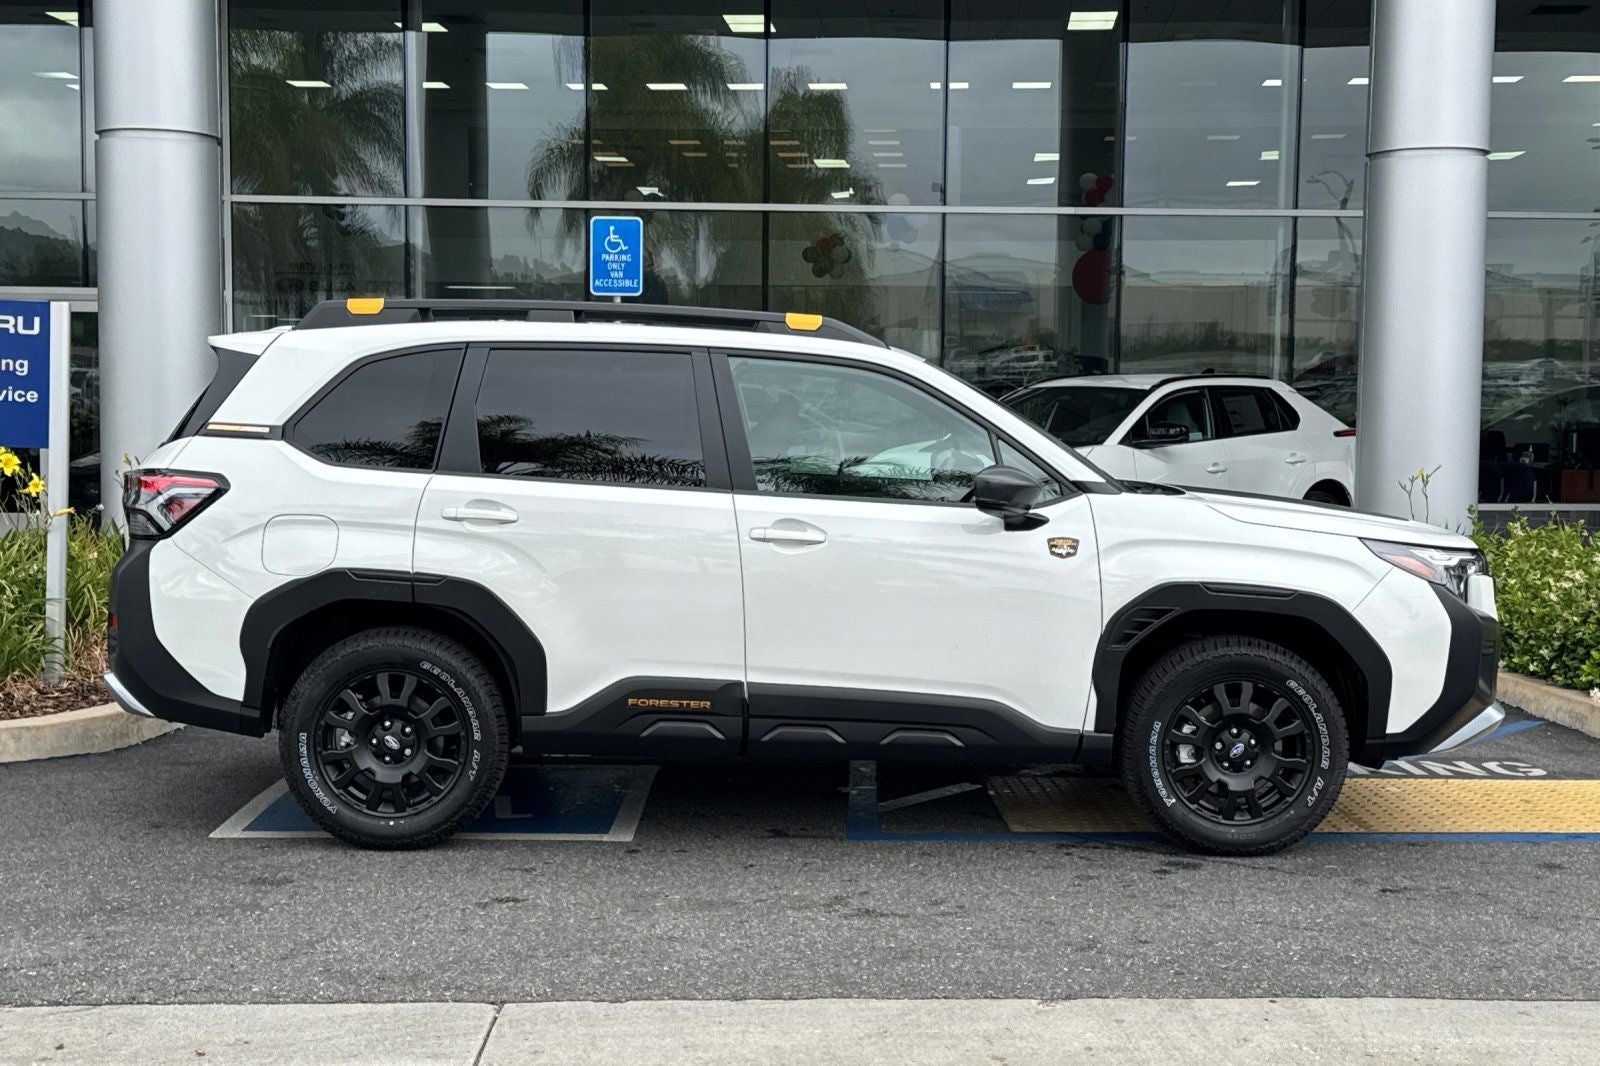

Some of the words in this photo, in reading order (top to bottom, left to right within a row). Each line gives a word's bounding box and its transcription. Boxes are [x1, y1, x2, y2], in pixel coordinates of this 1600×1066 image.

[601, 253, 632, 262] PARKING
[607, 262, 625, 270] ONLY
[594, 279, 639, 287] ACCESSIBLE
[420, 661, 481, 741] GEOLANDAR
[627, 698, 711, 709] FORESTER
[1286, 679, 1330, 769] GEOLANDAR
[299, 732, 338, 814] YOKOHAMA
[1149, 721, 1176, 807] YOKOHAMA
[1307, 776, 1324, 807] A/T
